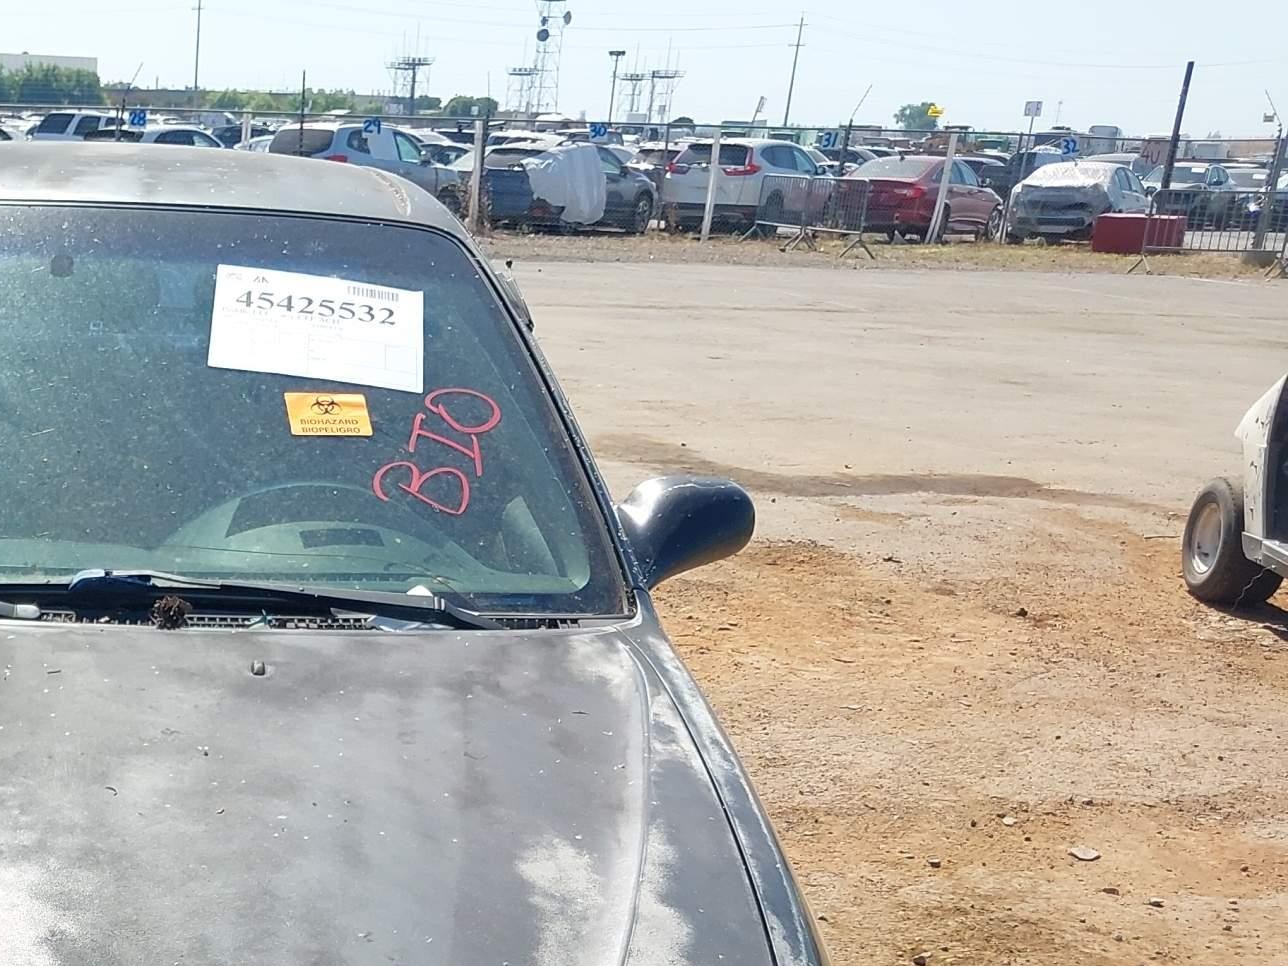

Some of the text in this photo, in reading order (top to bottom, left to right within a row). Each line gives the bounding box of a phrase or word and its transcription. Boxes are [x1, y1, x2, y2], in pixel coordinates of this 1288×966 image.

[129, 111, 146, 126] 28
[363, 117, 381, 135] 29
[589, 123, 607, 138] 30
[822, 131, 839, 147] 31
[1063, 138, 1080, 155] 32
[236, 290, 397, 326] 45425532
[301, 426, 361, 434] BIOPELIGRO
[372, 387, 502, 517] BIO
